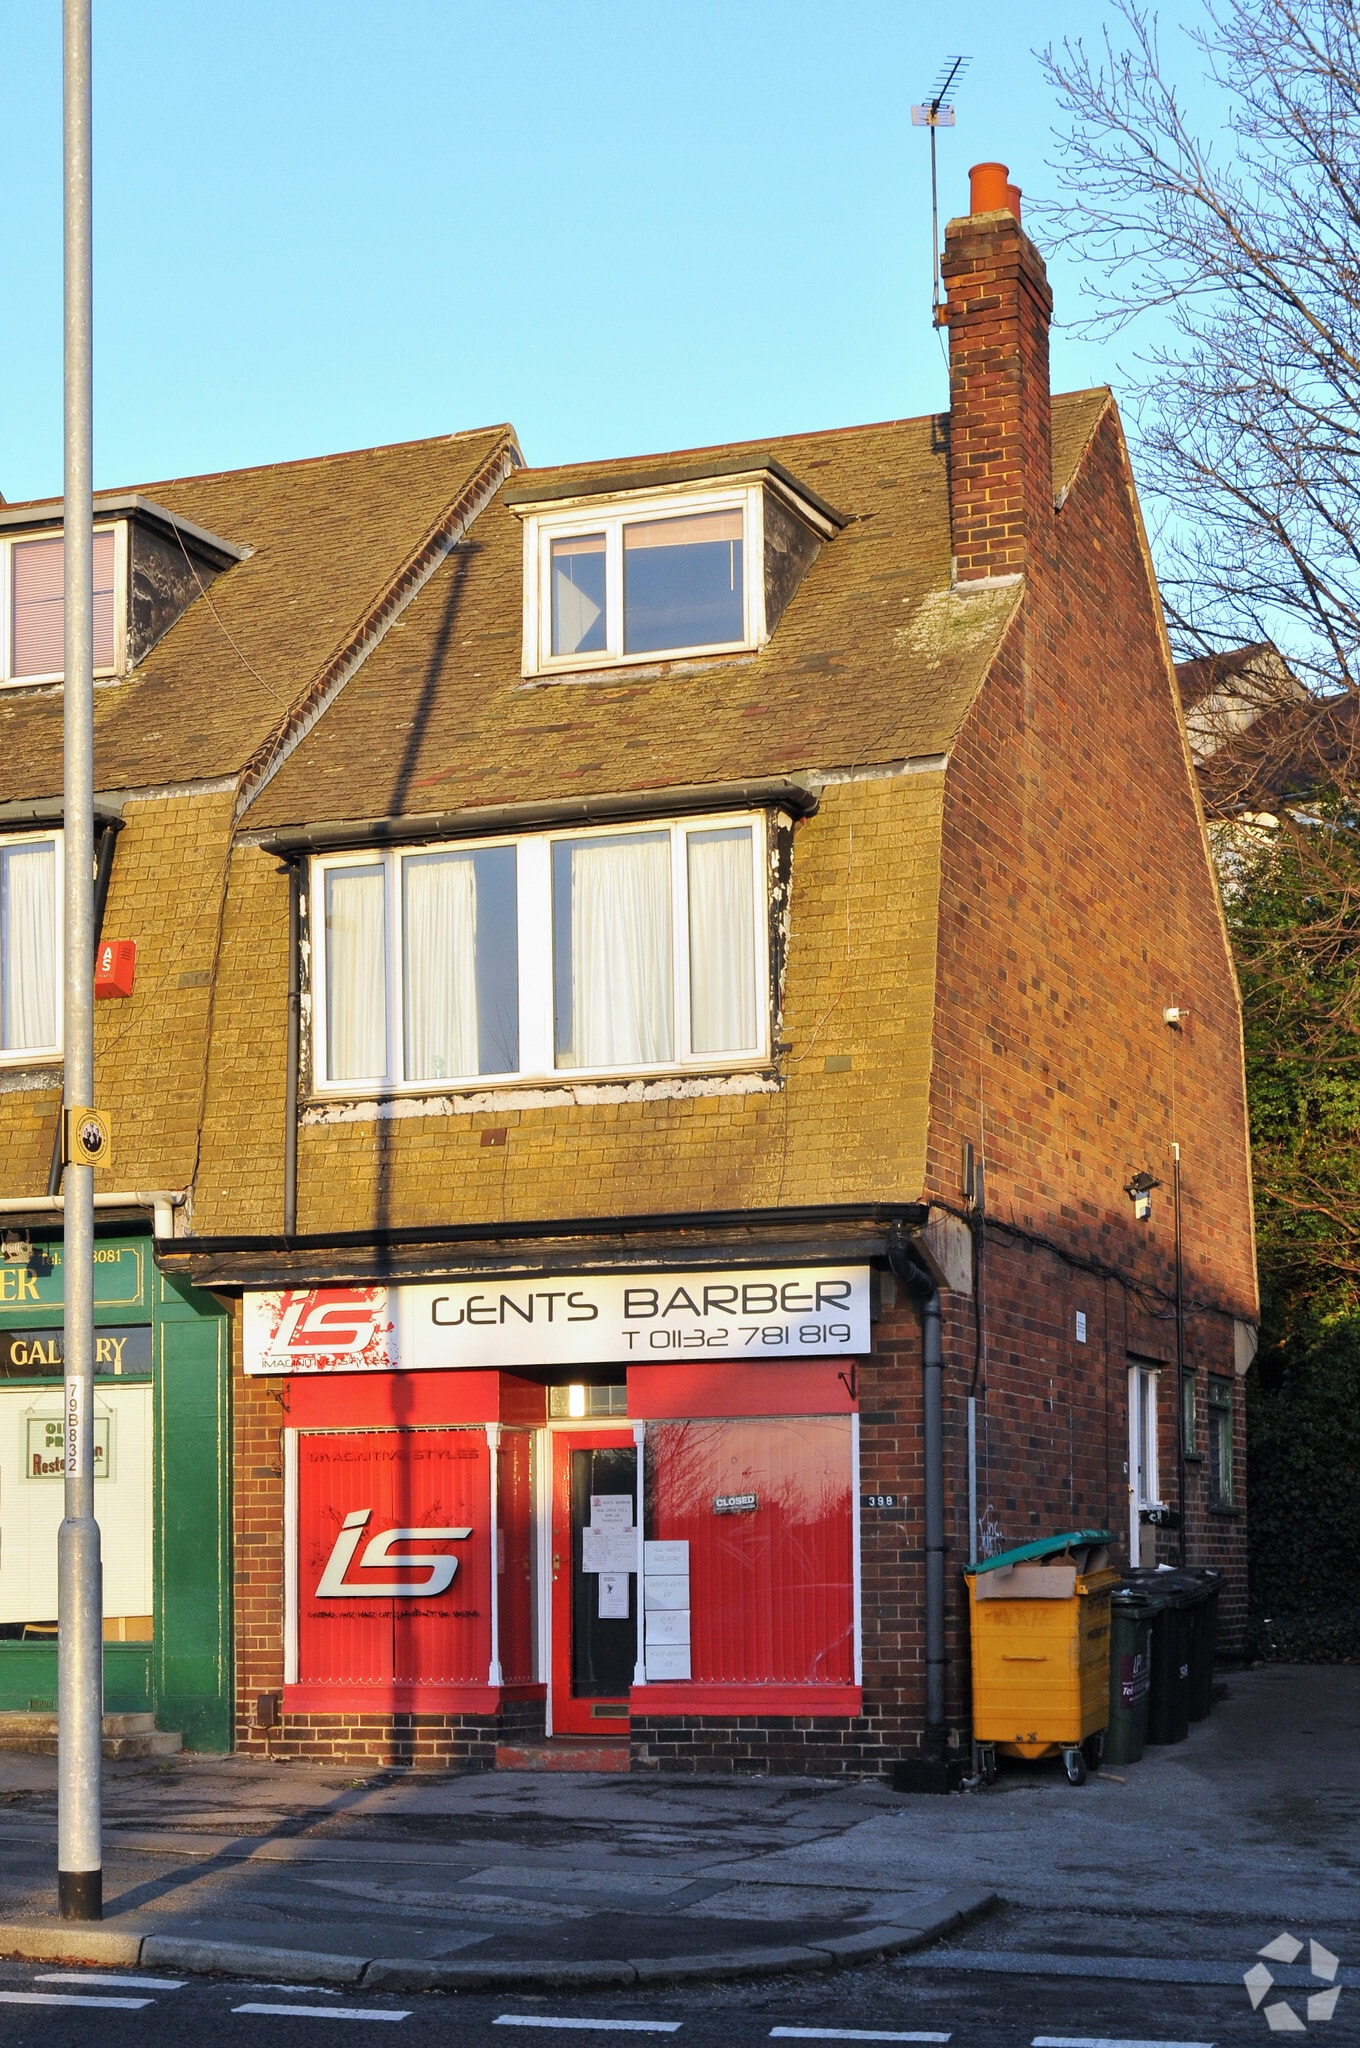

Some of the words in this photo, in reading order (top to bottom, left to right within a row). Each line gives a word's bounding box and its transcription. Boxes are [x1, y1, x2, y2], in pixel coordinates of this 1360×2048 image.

[431, 1291, 599, 1327] GENTS
[623, 1280, 853, 1319] BARBER
[621, 1331, 641, 1349] T
[649, 1328, 729, 1349] 01132
[738, 1325, 790, 1346] 781
[799, 1323, 851, 1344] 819
[10, 1337, 128, 1366] GALRY
[45, 1422, 65, 1435] OI
[68, 1383, 79, 1472] 79B832
[413, 1448, 480, 1461] STYLES
[716, 1495, 755, 1507] CLOSED
[868, 1496, 893, 1506] 398
